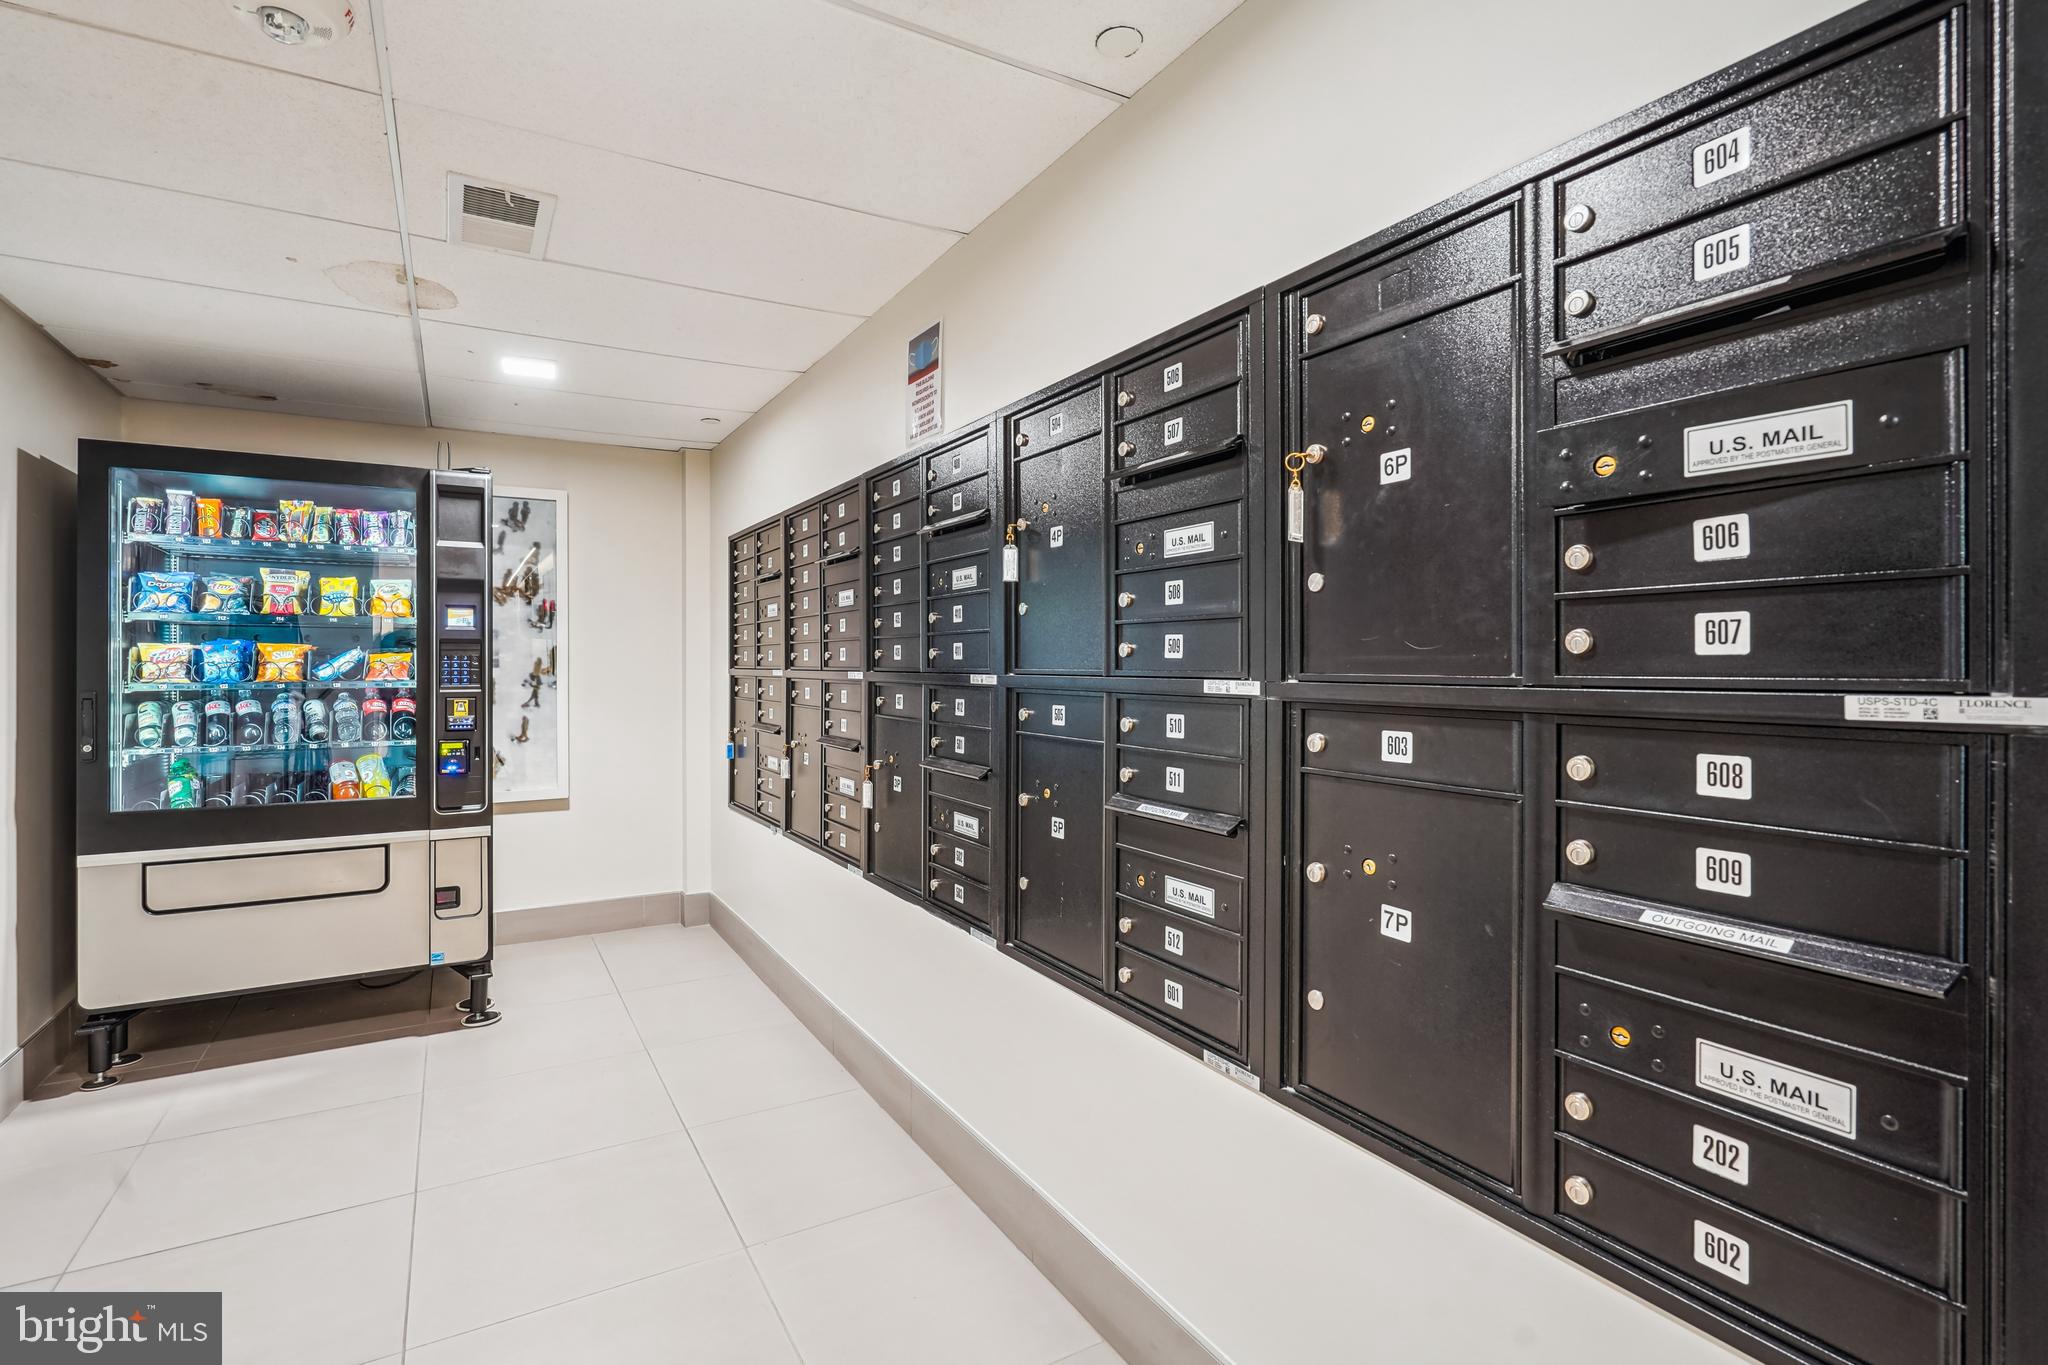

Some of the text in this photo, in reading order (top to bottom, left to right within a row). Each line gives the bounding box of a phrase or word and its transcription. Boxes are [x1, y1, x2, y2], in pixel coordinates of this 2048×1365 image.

[1704, 138, 1740, 175] 604
[1703, 234, 1740, 269] 605
[1167, 367, 1180, 386] 506
[1052, 416, 1061, 431] 504
[1168, 422, 1180, 440] 507
[1710, 425, 1824, 456] U.S. MAIL
[1692, 456, 1729, 468] APPROVED
[1730, 455, 1739, 463] BY
[1756, 445, 1805, 459] POSTMASTER
[1807, 440, 1842, 451] GENERAL
[1384, 456, 1408, 479] 6P
[1052, 529, 1062, 543] 4P
[1172, 537, 1185, 547] U.S.
[1188, 533, 1206, 544] MAIL
[1702, 522, 1739, 551] 606
[1168, 584, 1181, 599] 508
[1705, 619, 1742, 646] 607
[1168, 638, 1181, 653] 509
[1857, 697, 2032, 709] USPS-STD-4C FLORENCE
[1054, 708, 1064, 721] 505
[1169, 718, 1182, 734] 510
[1387, 736, 1408, 756] 603
[1169, 771, 1181, 787] 511
[1707, 761, 1743, 789] 608
[1053, 820, 1063, 834] 5P
[1706, 853, 1743, 886] 609
[1172, 886, 1186, 899] U.S.
[1188, 892, 1207, 906] MAIL
[1383, 910, 1409, 932] 7P
[1652, 914, 1779, 948] OUTGOING MAIL
[1168, 931, 1180, 950] 512
[1167, 984, 1179, 1003] 601
[1720, 1062, 1829, 1111] U.S. MAIL
[1704, 1074, 1847, 1128] APPROVED BY THE POSTMASTER GENERAL
[1703, 1136, 1740, 1173] 202
[1704, 1231, 1740, 1272] 602
